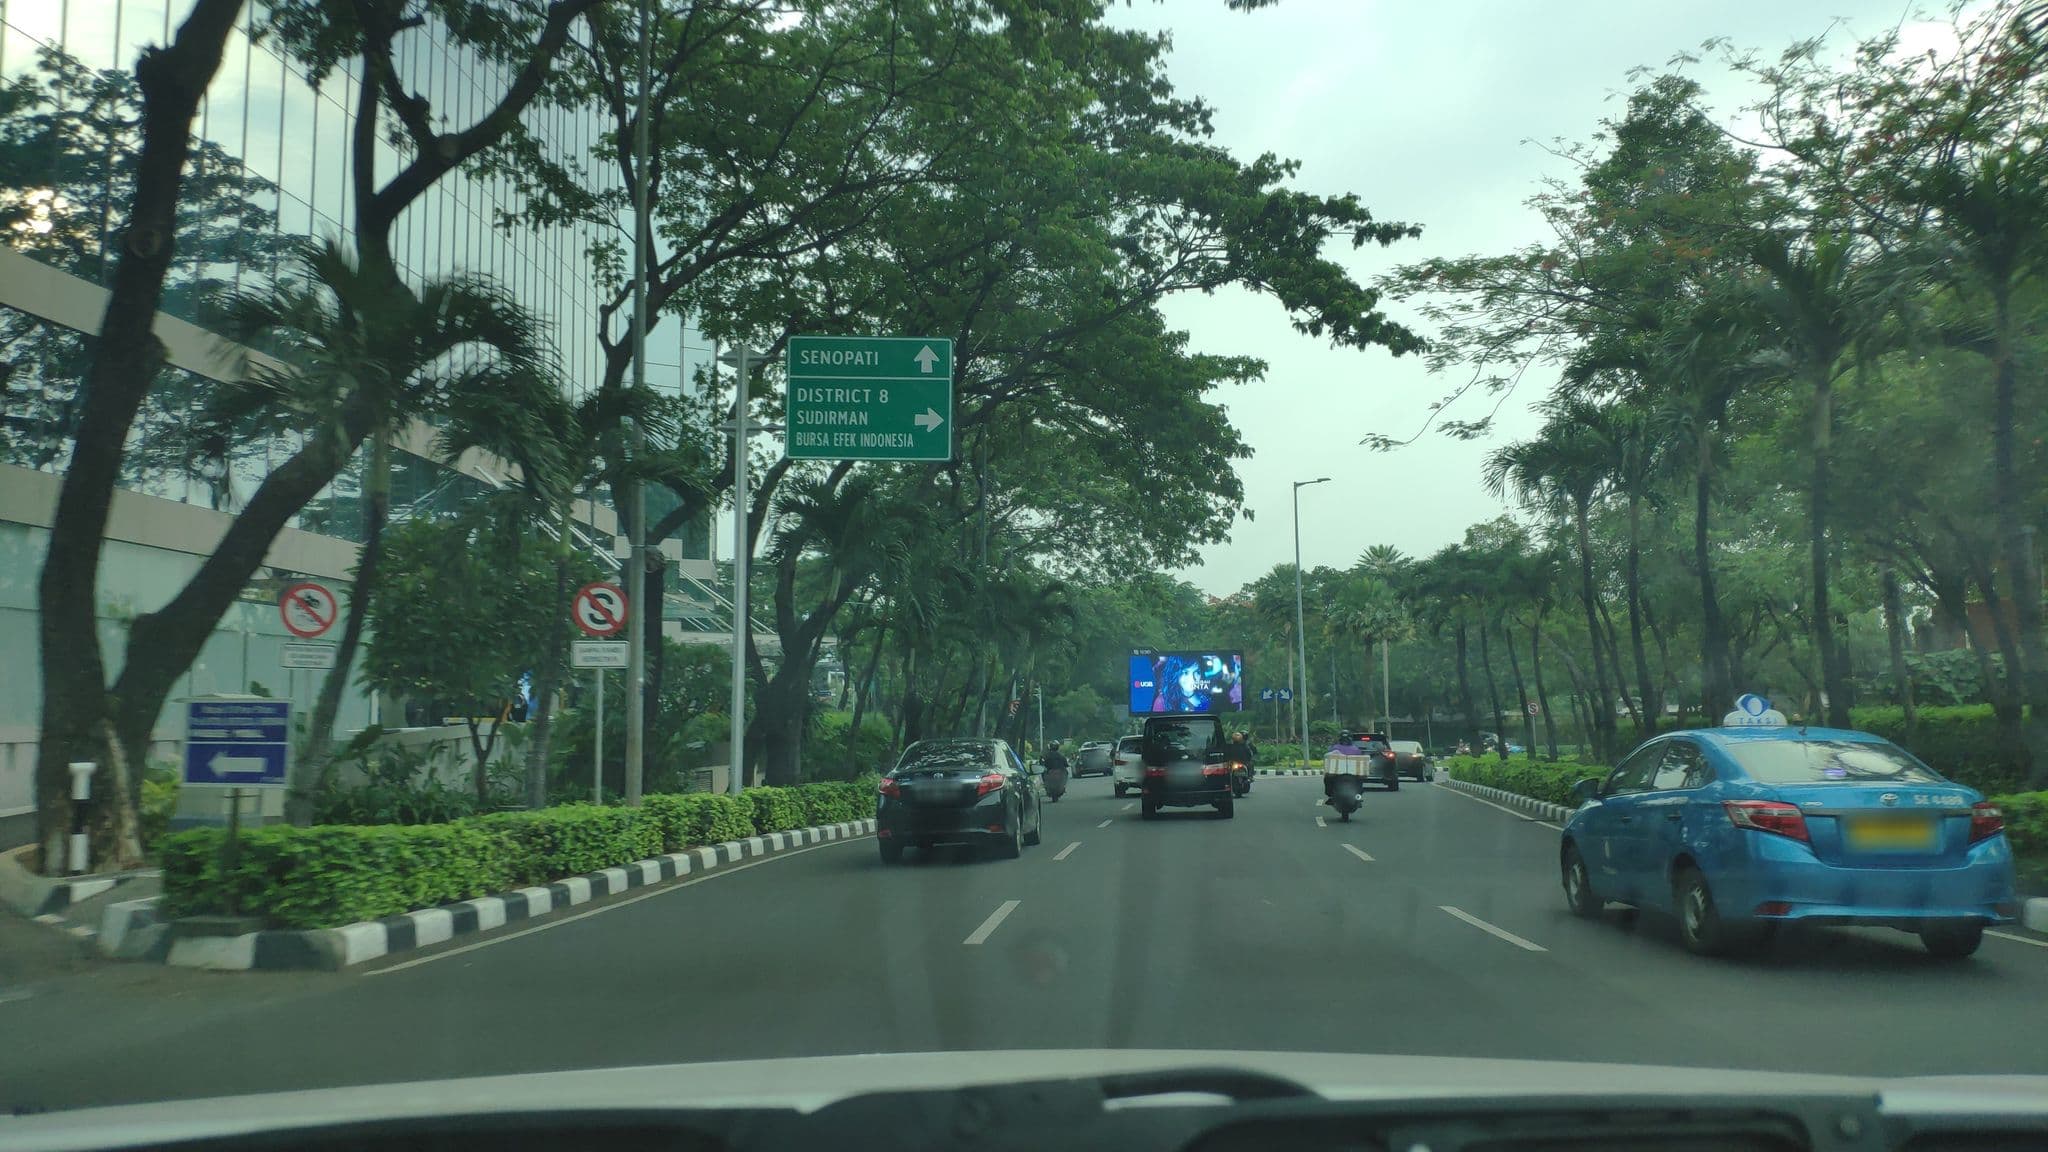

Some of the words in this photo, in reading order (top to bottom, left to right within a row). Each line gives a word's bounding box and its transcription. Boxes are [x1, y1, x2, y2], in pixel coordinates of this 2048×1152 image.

[800, 350, 879, 366] SENOPATI
[797, 388, 872, 404] DISTRICT
[879, 389, 889, 404] 8
[796, 410, 868, 426] SUDIRMAN
[796, 432, 830, 447] BURSA
[833, 433, 857, 448] EFEK
[860, 433, 914, 448] INDONESIA
